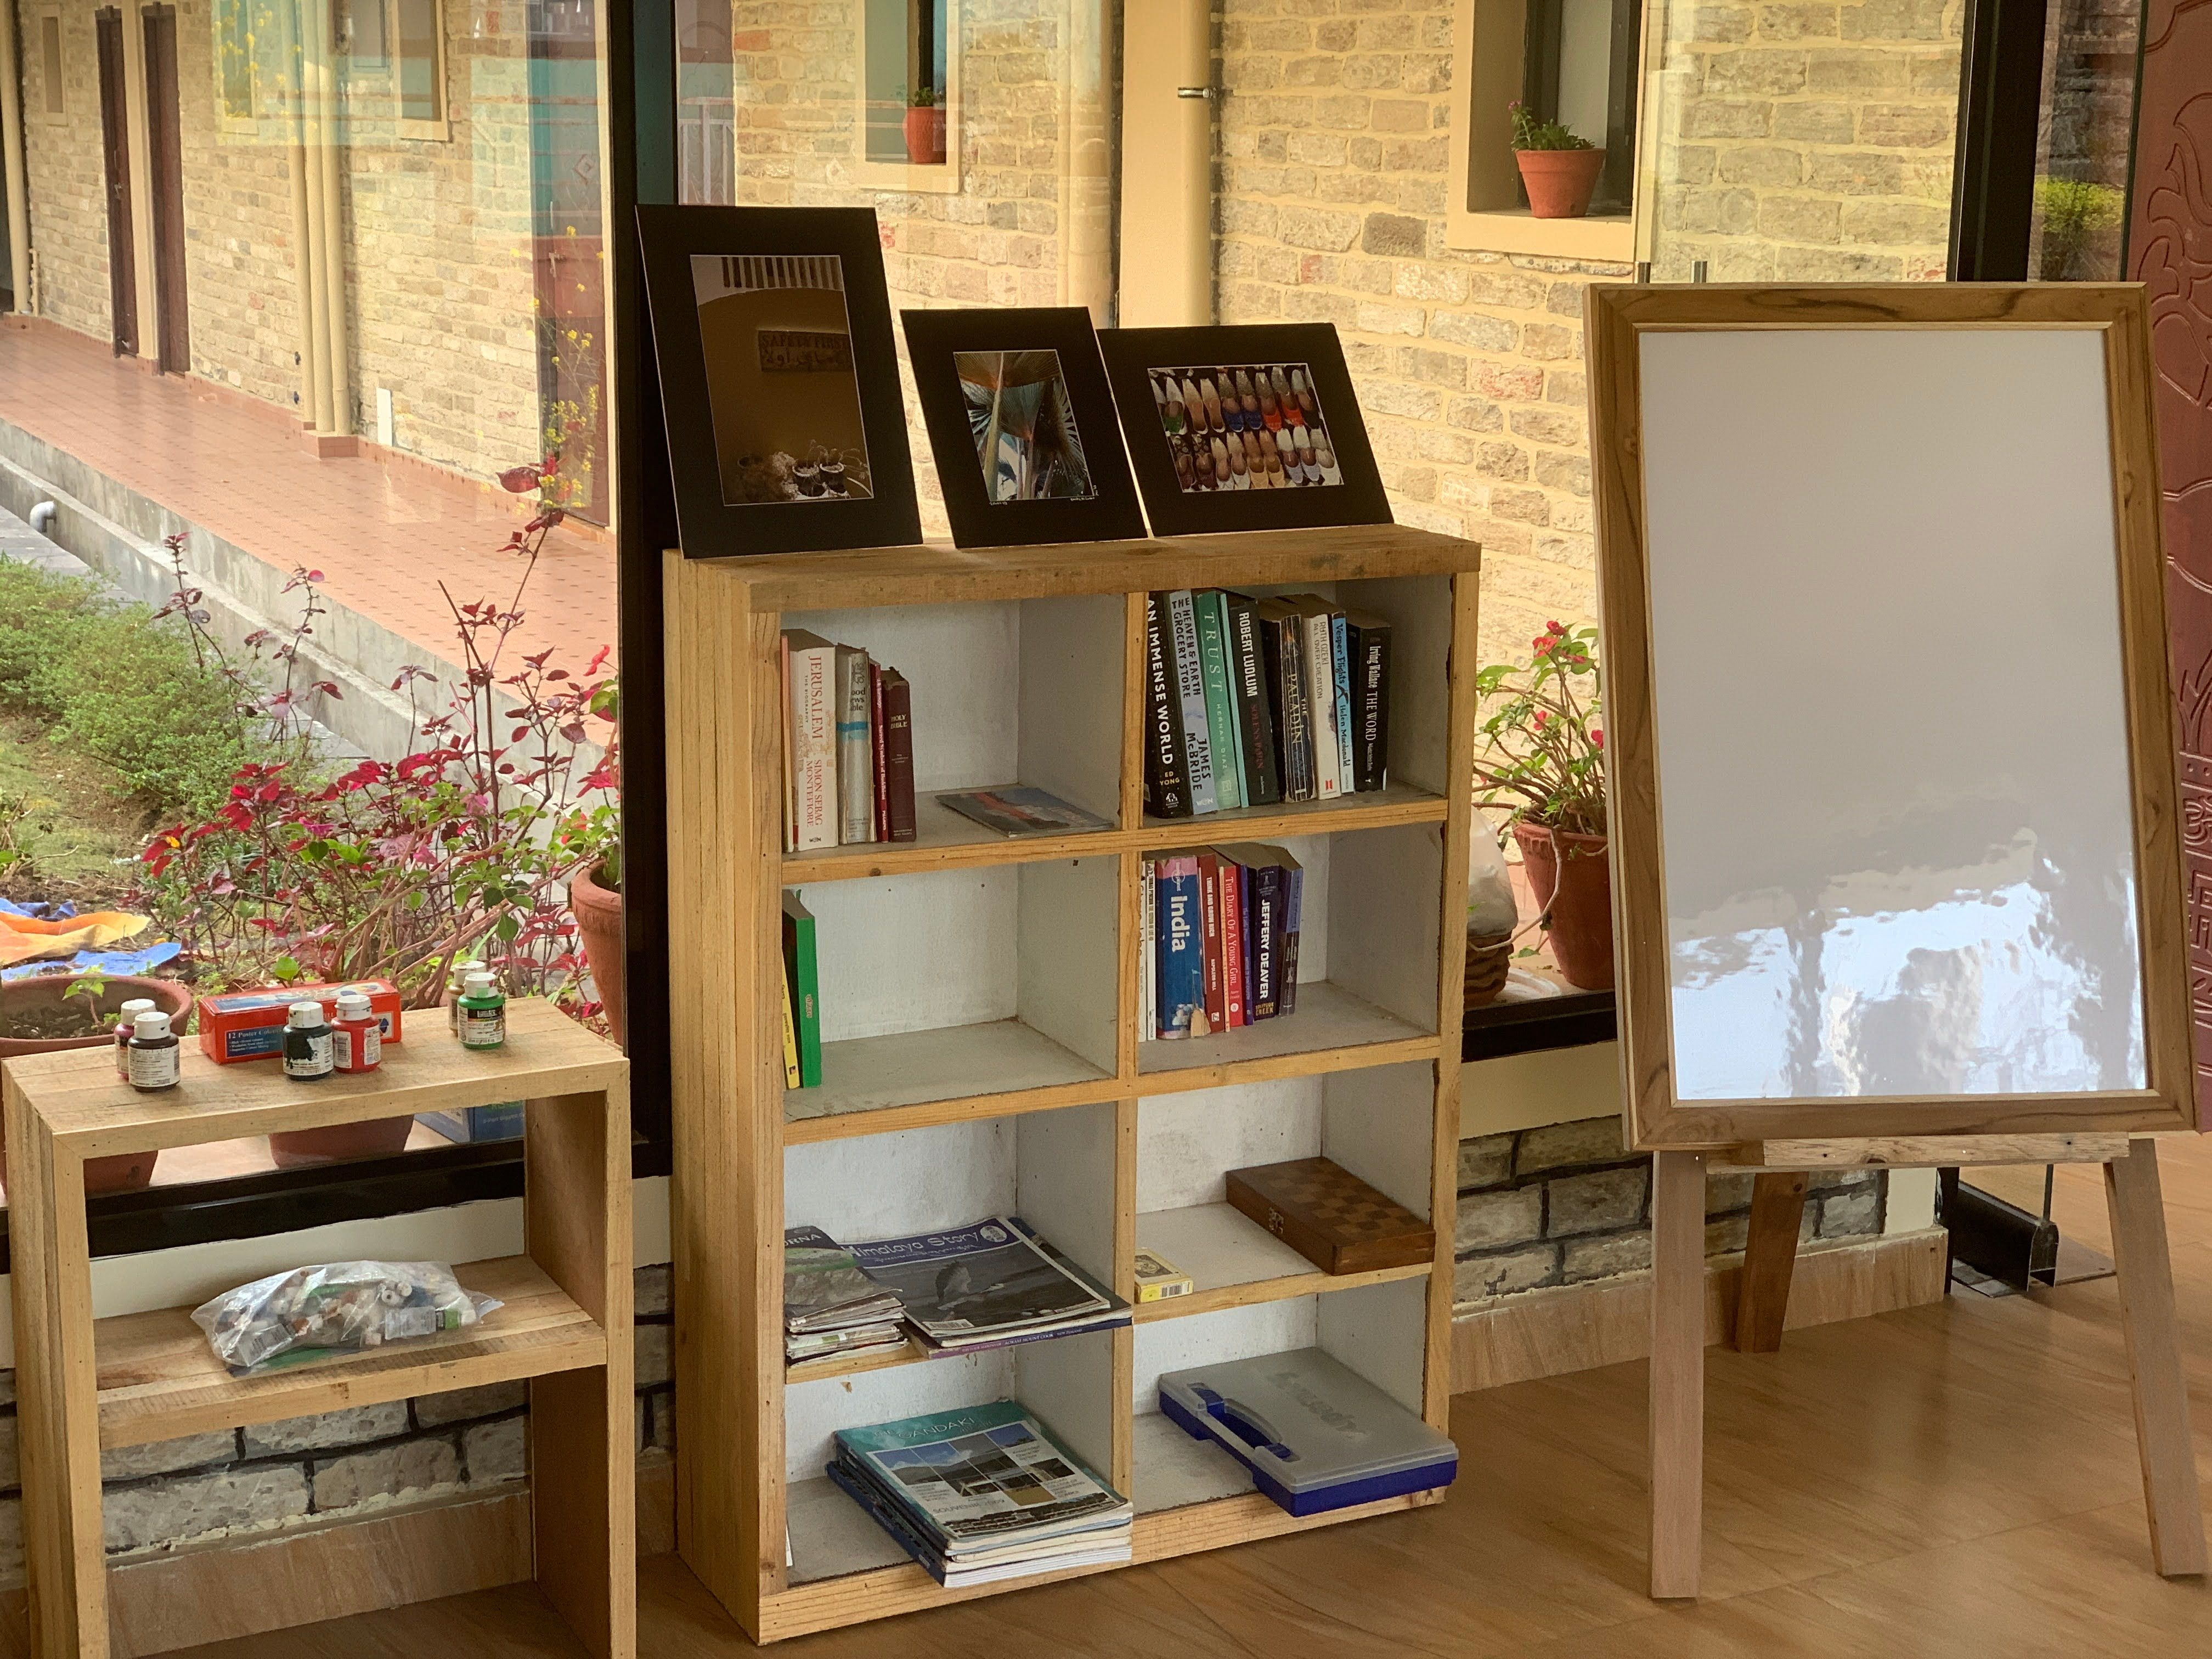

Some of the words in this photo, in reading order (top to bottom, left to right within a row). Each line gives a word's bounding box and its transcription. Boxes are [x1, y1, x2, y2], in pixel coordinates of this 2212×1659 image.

[1182, 609, 1195, 649] HEAVEN
[1239, 612, 1254, 652] ROBERT
[1150, 627, 1166, 702] IMMENSE
[1173, 612, 1187, 660] GROCERY
[1180, 663, 1191, 698] STORE
[1188, 650, 1195, 659] &
[1203, 612, 1223, 692] TRUST
[1321, 643, 1329, 665] OZEKI
[1367, 646, 1381, 664] Irving
[1189, 662, 1201, 696] EARTH
[1243, 652, 1258, 697] LUDLUM
[1335, 656, 1346, 684] Flights
[1368, 664, 1380, 689] Wallace
[808, 656, 823, 740] JERUSALEM
[851, 687, 866, 696] ood
[1366, 691, 1378, 709] THE
[1215, 703, 1224, 742] HERNAN
[1287, 673, 1302, 744] PALADIN
[1156, 707, 1173, 765] WORLD
[1364, 710, 1377, 741] WORD
[1186, 732, 1203, 791] McBRIDE
[1197, 738, 1211, 779] JAMES
[1341, 729, 1351, 767] Macdonald
[814, 759, 822, 791] SIMON
[1160, 777, 1180, 786] YONG
[814, 793, 823, 826] SEBAG
[1224, 877, 1233, 894] THE
[1226, 894, 1234, 917] DIARY
[1170, 895, 1190, 953] India
[1227, 919, 1236, 932] OF
[1228, 934, 1235, 943] A
[1260, 900, 1271, 952] JEFFERY
[1228, 943, 1237, 967] YOUNG
[1229, 967, 1237, 986] GIRL
[1259, 952, 1269, 1000] DEAVER
[1256, 1007, 1273, 1016] CREEK
[228, 1031, 236, 1040] 12
[238, 1030, 258, 1039] Poster
[840, 1242, 924, 1257] Himalaya
[927, 1232, 979, 1246] Story
[899, 1417, 975, 1438] GANDAKI
